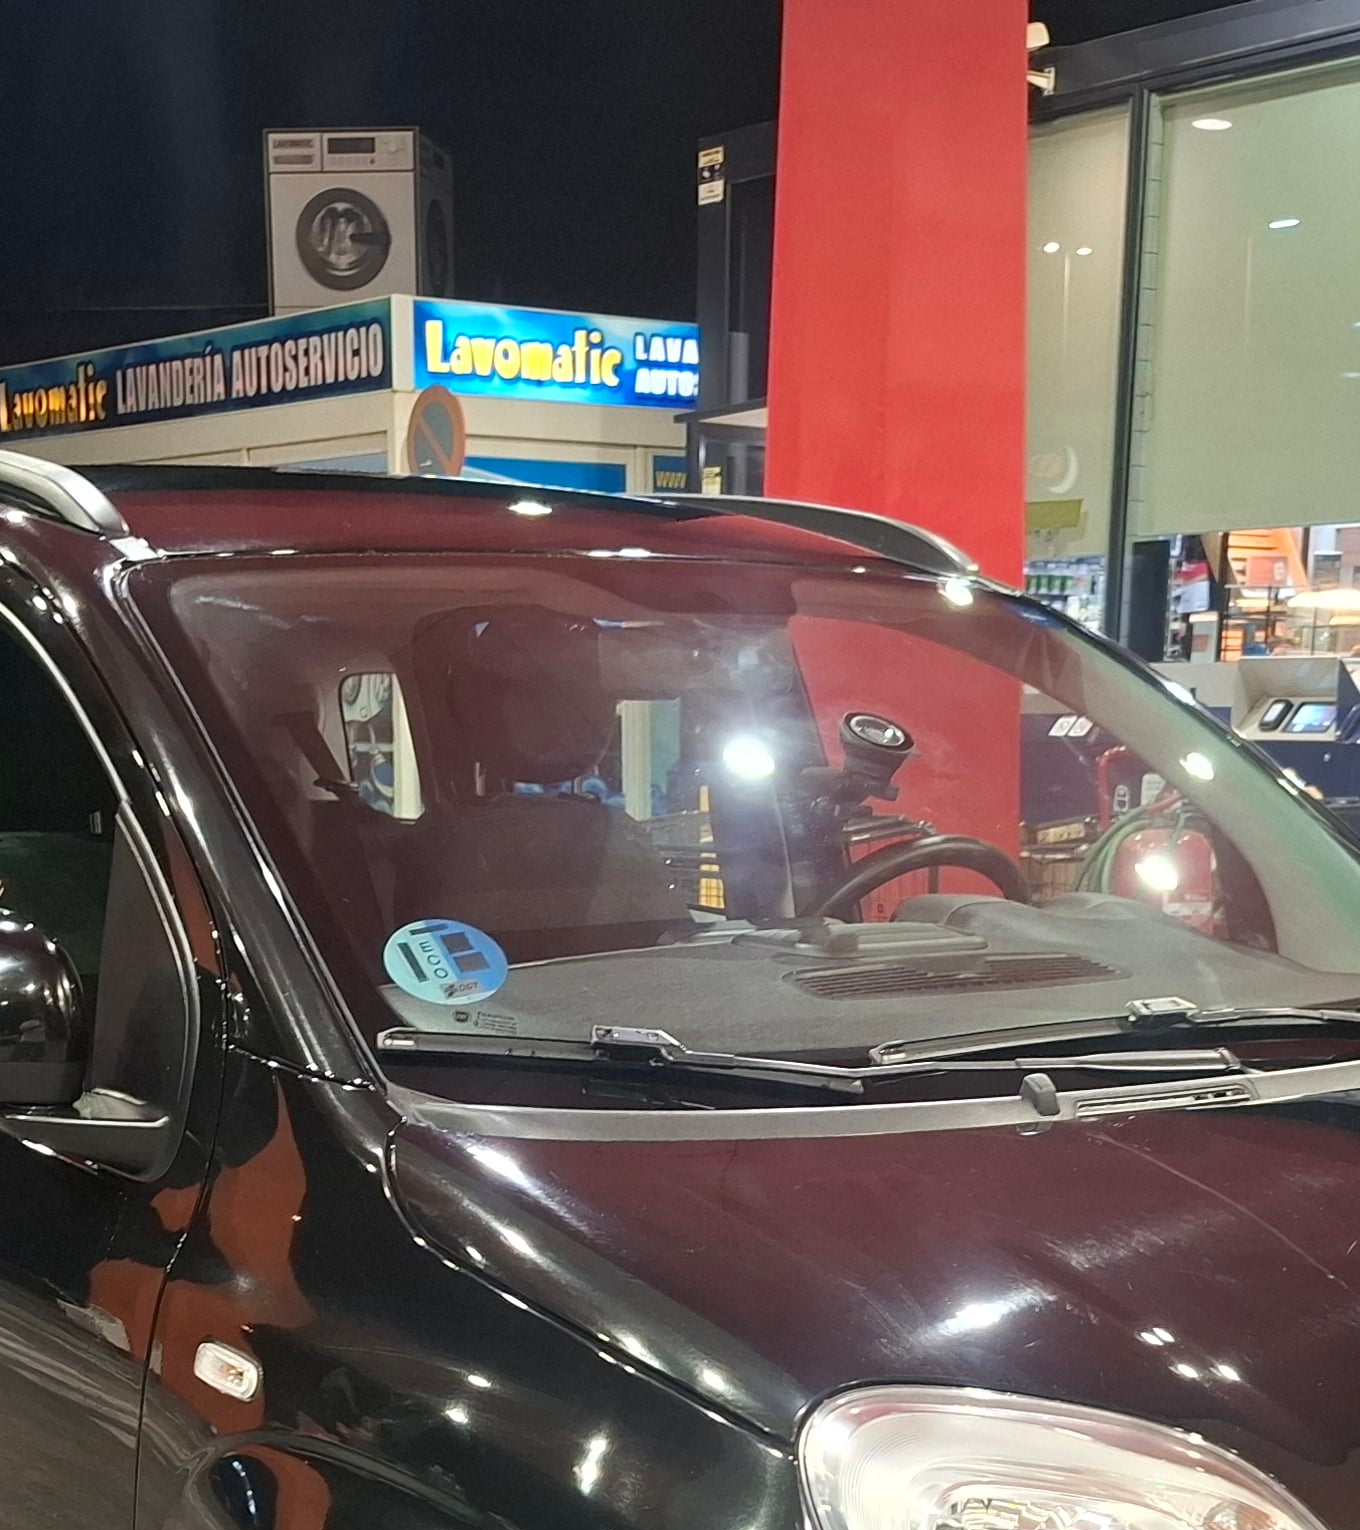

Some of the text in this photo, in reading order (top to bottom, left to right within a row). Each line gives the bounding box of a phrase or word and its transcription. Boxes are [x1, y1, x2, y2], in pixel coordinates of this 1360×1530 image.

[115, 345, 226, 415] LAVANDERÍA
[231, 323, 384, 399] AUTOSERVICIO
[425, 320, 622, 387] Lavomatic
[635, 334, 699, 365] LAVA
[418, 941, 449, 980] ECO
